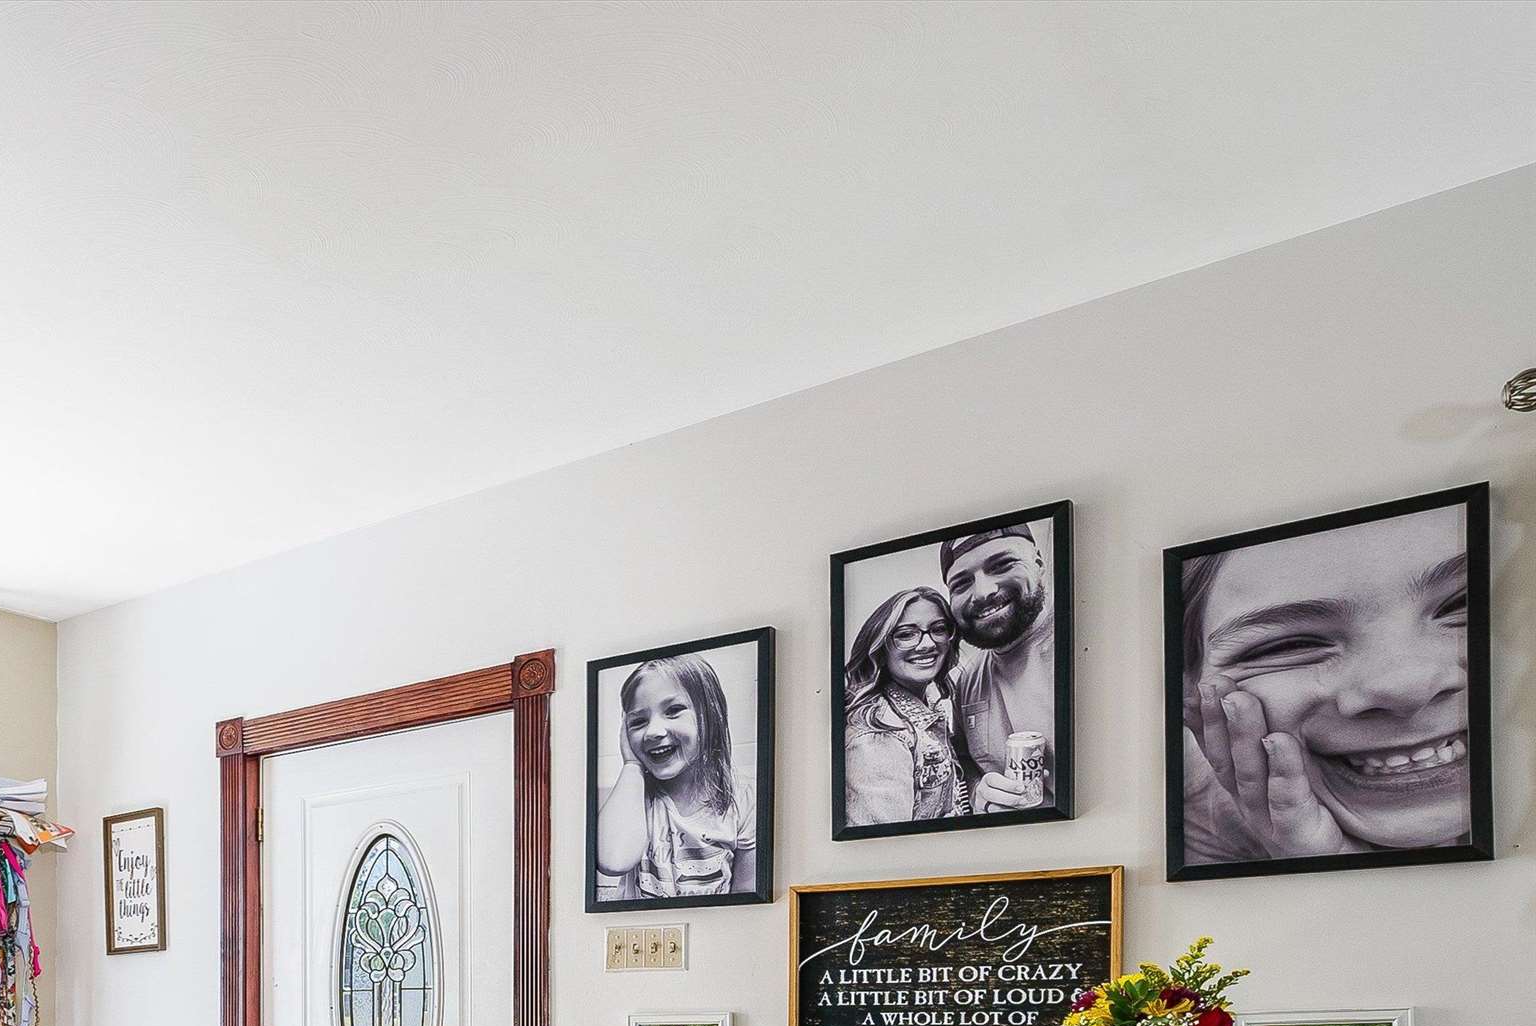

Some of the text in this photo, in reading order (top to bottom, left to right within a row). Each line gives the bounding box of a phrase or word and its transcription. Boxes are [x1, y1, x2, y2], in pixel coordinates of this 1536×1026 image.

[118, 849, 149, 880] Enjoy
[125, 879, 151, 899] little
[119, 898, 150, 923] things
[799, 896, 1112, 970] family
[819, 963, 1083, 985] A LITTLE BIT OF CRAZY
[818, 991, 833, 1007] A
[837, 990, 909, 1007] LITTLE
[914, 989, 947, 1006] BIT
[953, 988, 988, 1005] OF
[992, 987, 1064, 1005] LOUD
[862, 1010, 1039, 1026] A WHOLE LOT OF
